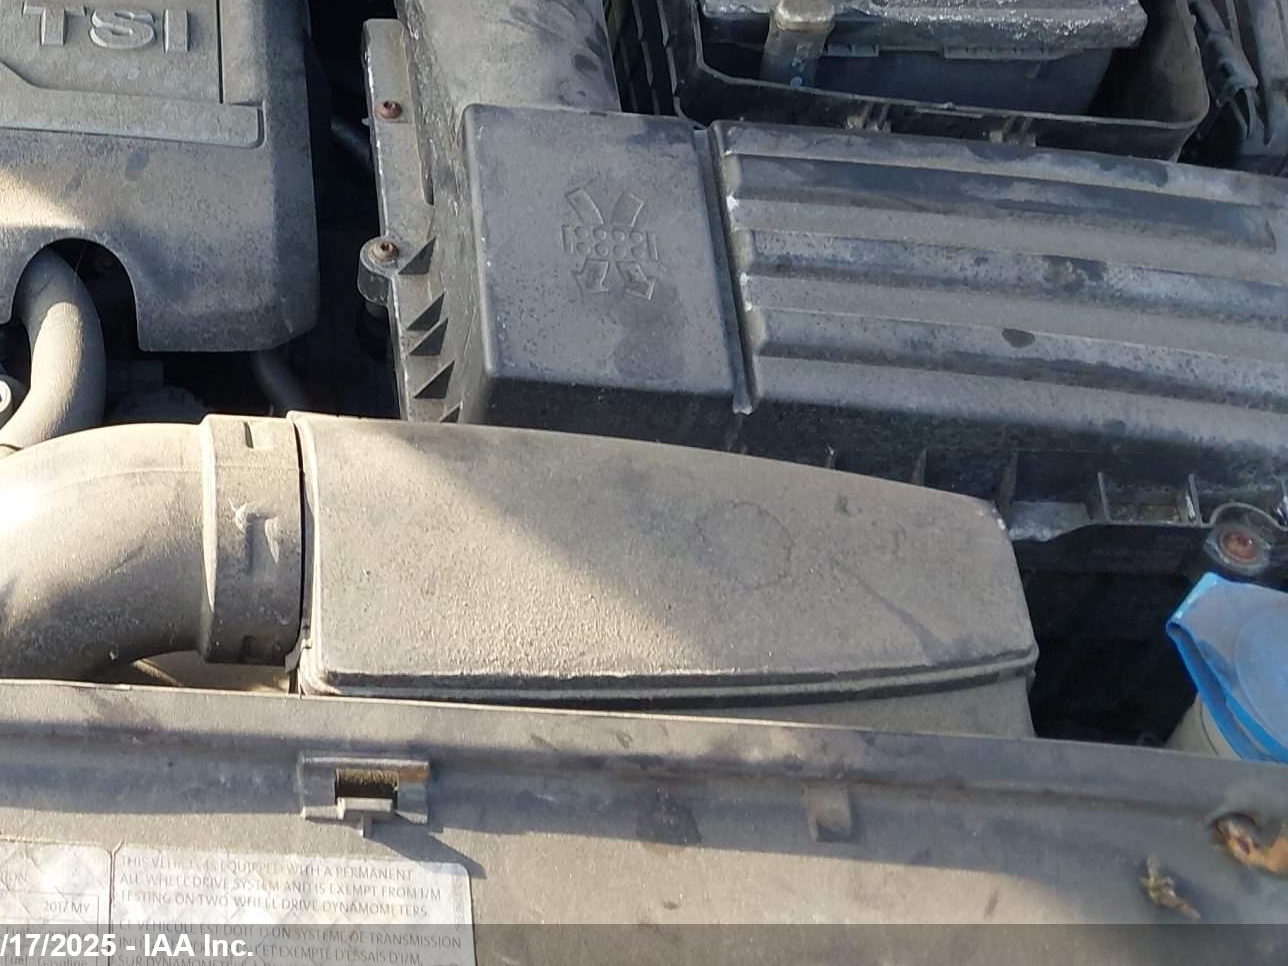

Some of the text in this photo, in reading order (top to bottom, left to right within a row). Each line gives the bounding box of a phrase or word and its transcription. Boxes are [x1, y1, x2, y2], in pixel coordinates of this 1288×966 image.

[22, 1, 191, 52] TSI
[121, 856, 150, 869] THIS
[286, 862, 321, 877] WITH
[323, 865, 333, 877] A
[336, 866, 414, 883] PERMANENT
[120, 873, 139, 885] ALL
[145, 874, 190, 889] WHEEL
[192, 876, 228, 890] DRIVE
[233, 878, 280, 891] SYSTEM
[285, 882, 312, 894] AND
[314, 884, 326, 895] IS
[329, 884, 377, 898] EXEMPT
[381, 886, 418, 900] FROM
[120, 889, 172, 905] TESTING
[175, 892, 195, 905] ON
[197, 893, 229, 907] TWO
[233, 895, 278, 910] WHEEL
[281, 898, 318, 912] DRIVE
[370, 933, 462, 949] TRANSMISSION
